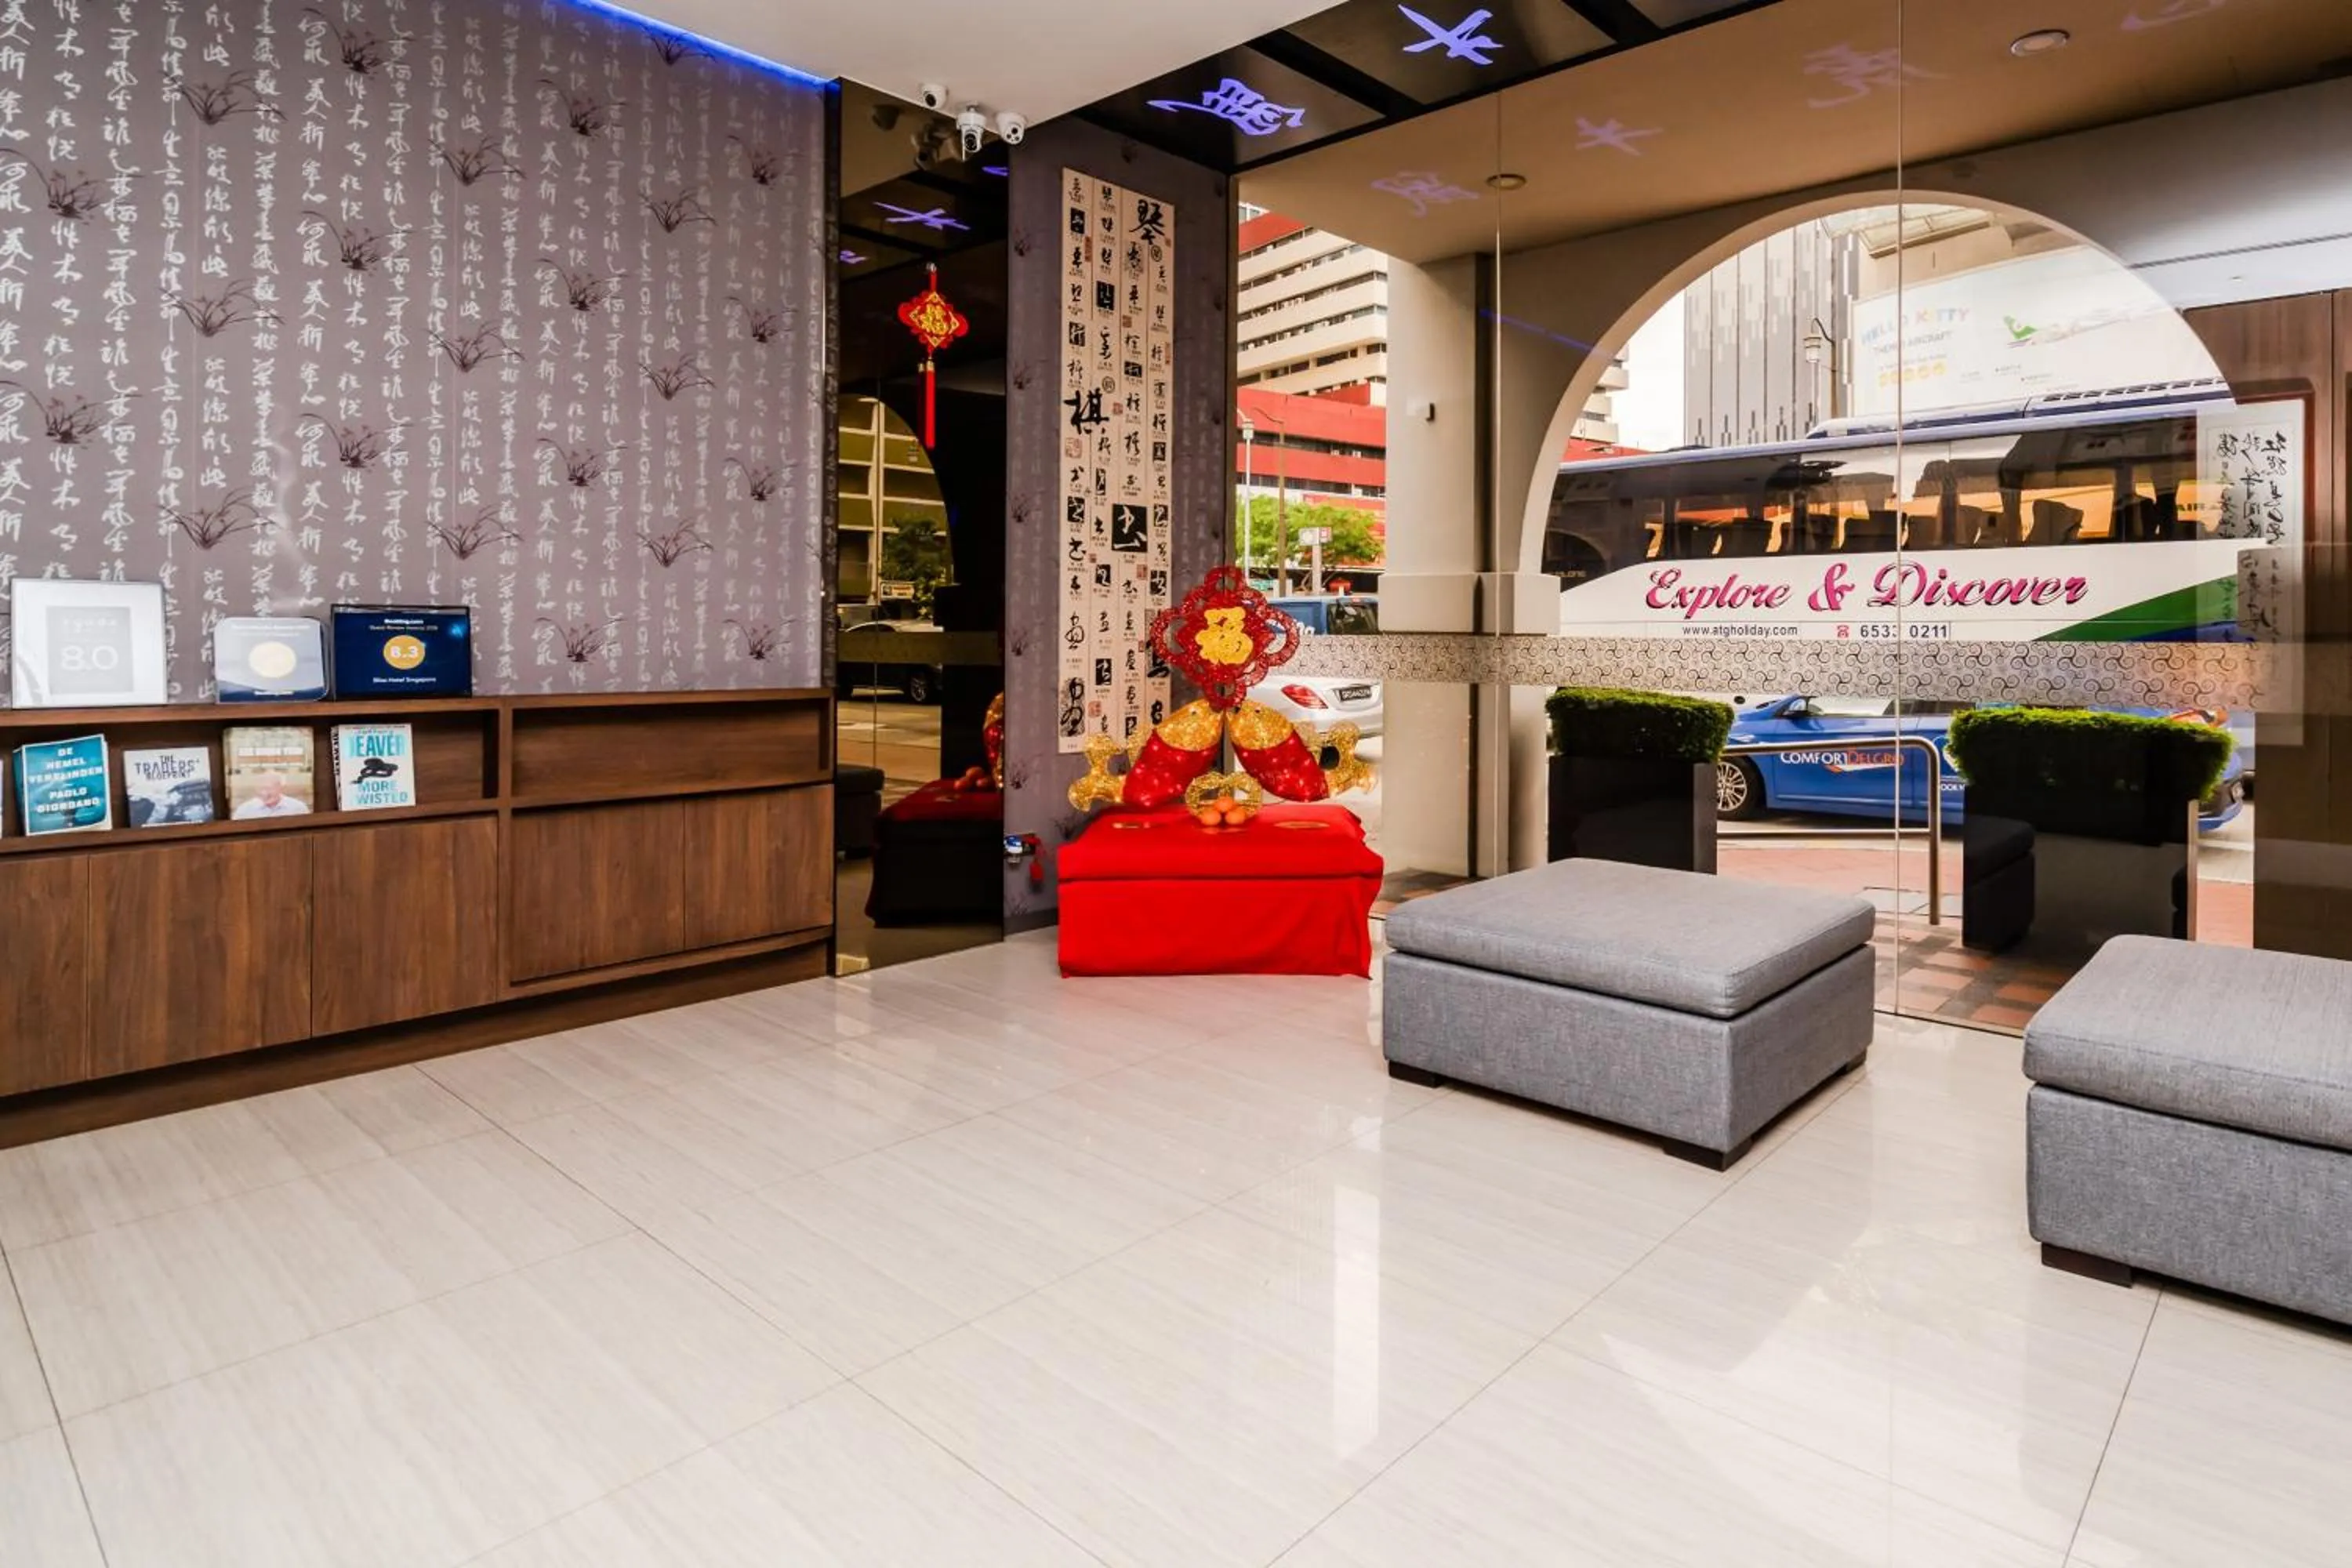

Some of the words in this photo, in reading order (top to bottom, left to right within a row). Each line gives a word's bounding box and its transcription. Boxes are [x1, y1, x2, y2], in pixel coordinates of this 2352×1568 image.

[1646, 567, 1793, 619] Explore
[1808, 562, 1855, 611] &
[1867, 559, 2089, 608] Discover
[1682, 626, 1798, 638] www.atgholiday.com
[1909, 624, 1947, 638] 0211
